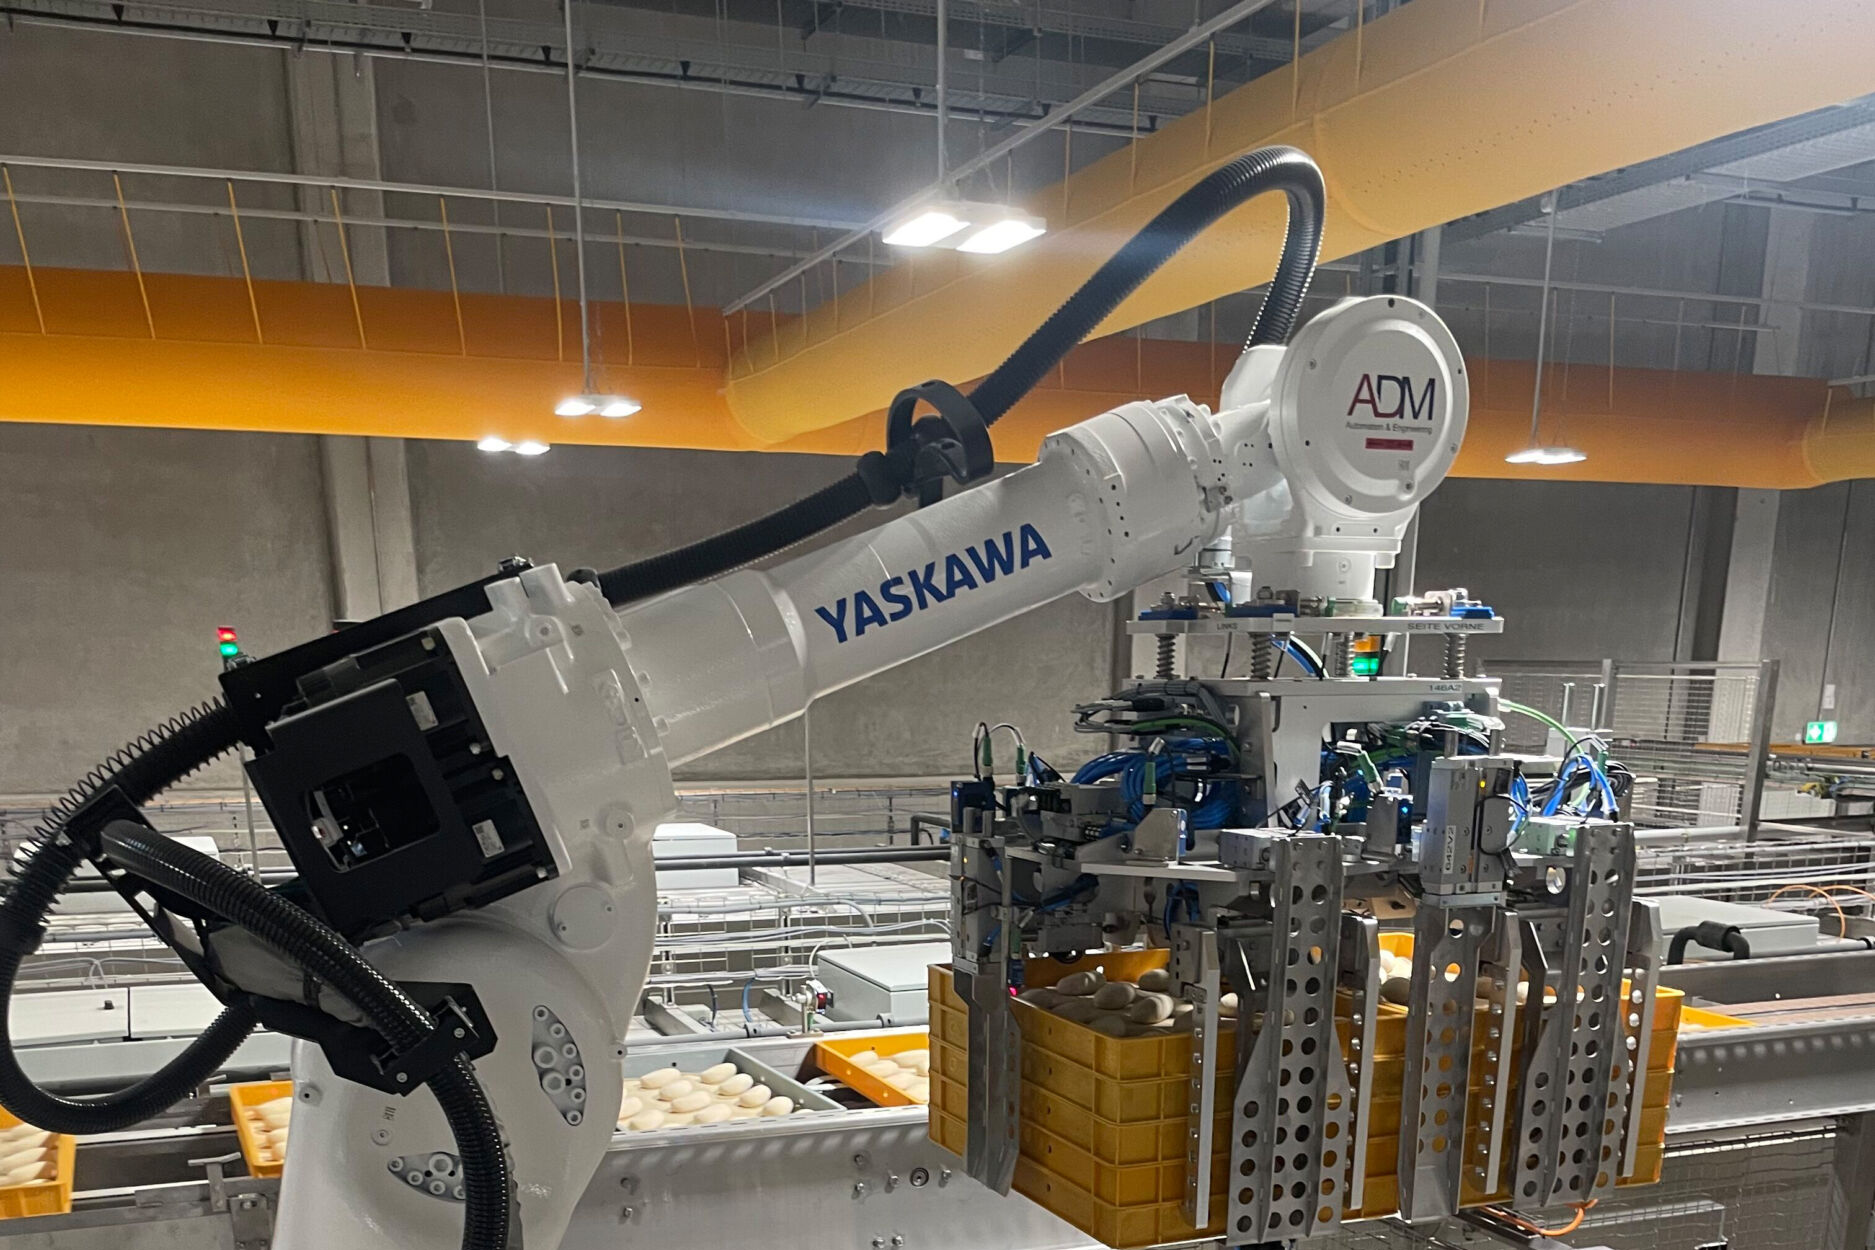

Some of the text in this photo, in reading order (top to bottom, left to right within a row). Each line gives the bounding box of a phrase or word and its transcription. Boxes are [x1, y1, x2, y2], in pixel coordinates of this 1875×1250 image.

[1347, 373, 1435, 420] ADM
[814, 523, 1052, 643] YASKAWA
[1217, 623, 1238, 631] LINKS
[1408, 622, 1484, 631] SEITE VORNE
